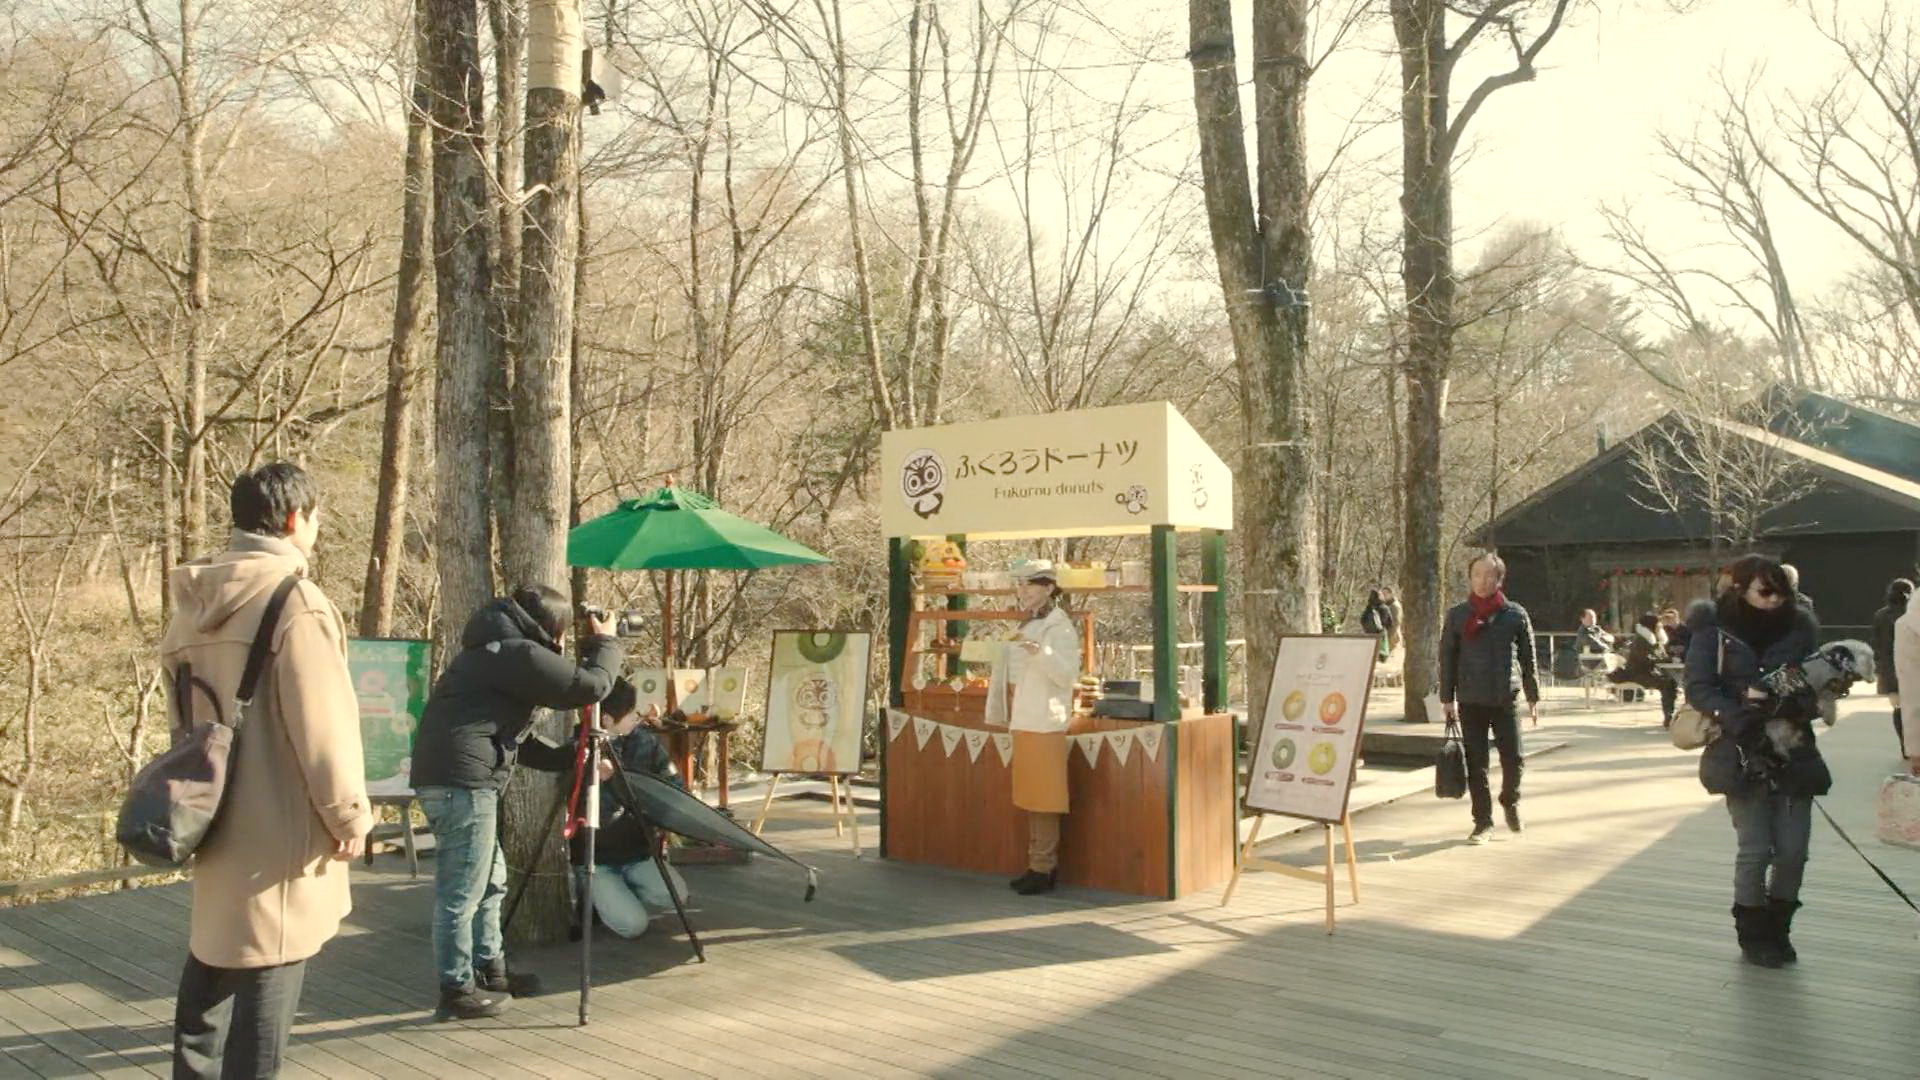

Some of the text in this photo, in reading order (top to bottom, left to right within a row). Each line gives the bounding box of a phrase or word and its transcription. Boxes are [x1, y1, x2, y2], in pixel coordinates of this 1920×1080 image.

[955, 440, 1138, 479] ふくろうドーナツ
[994, 480, 1104, 499] Fukurou donuts
